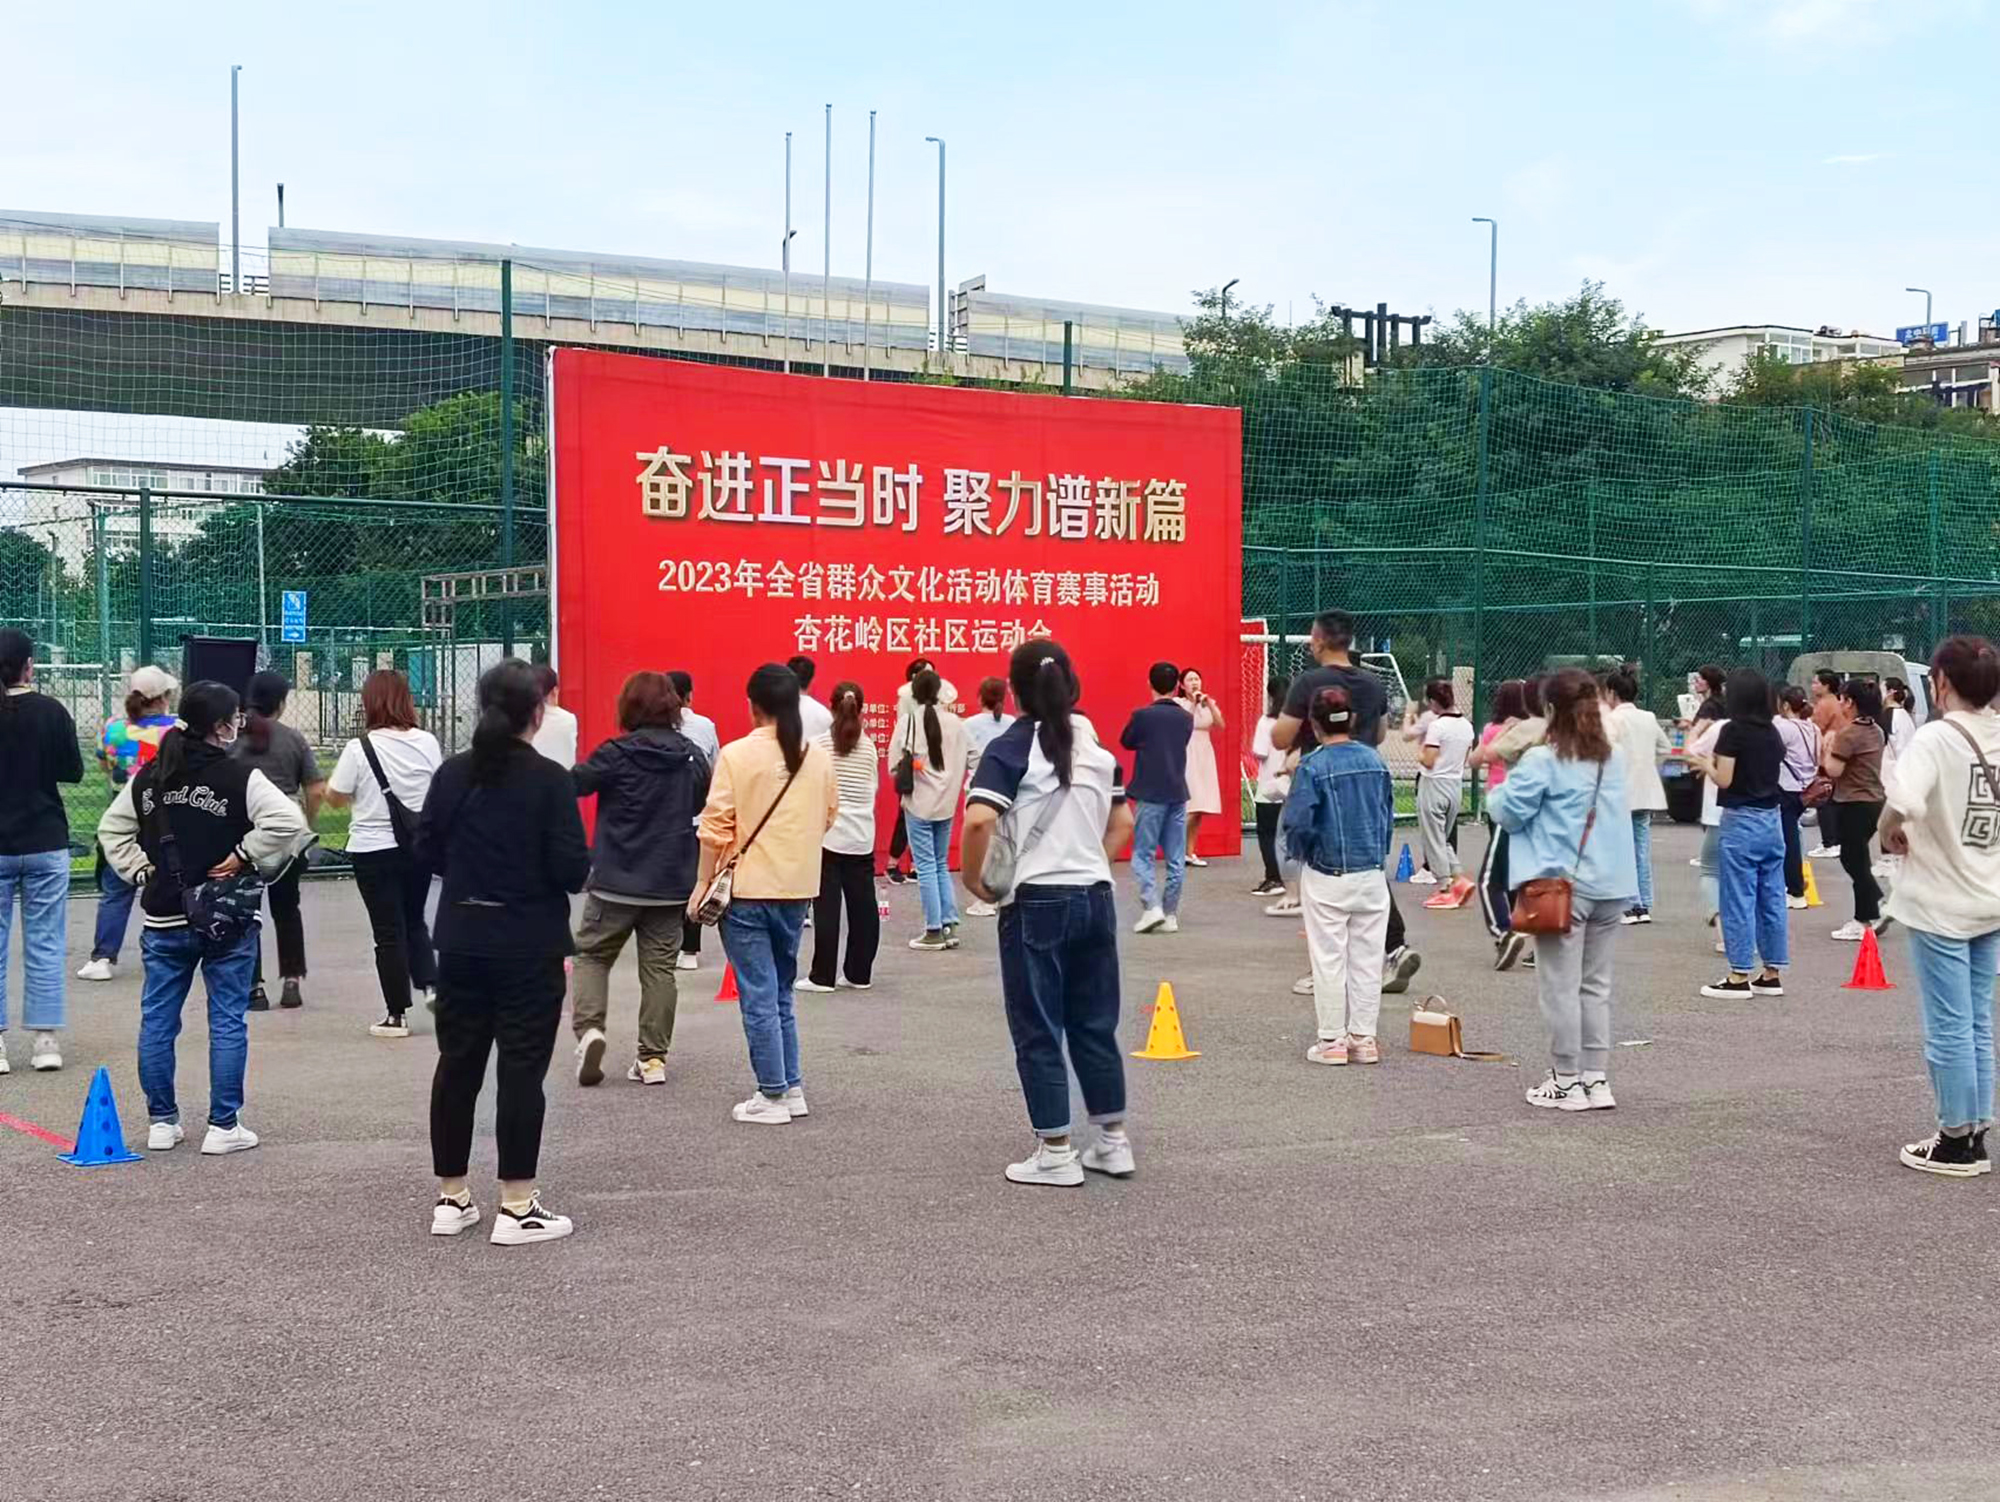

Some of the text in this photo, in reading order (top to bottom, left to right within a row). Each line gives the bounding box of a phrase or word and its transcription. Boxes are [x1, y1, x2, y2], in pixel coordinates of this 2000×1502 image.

[635, 445, 1187, 543] 奋进正当时 聚力谱新篇
[658, 558, 1160, 608] 2023年全省群众文化活动体育赛事活动
[189, 785, 229, 816] Club
